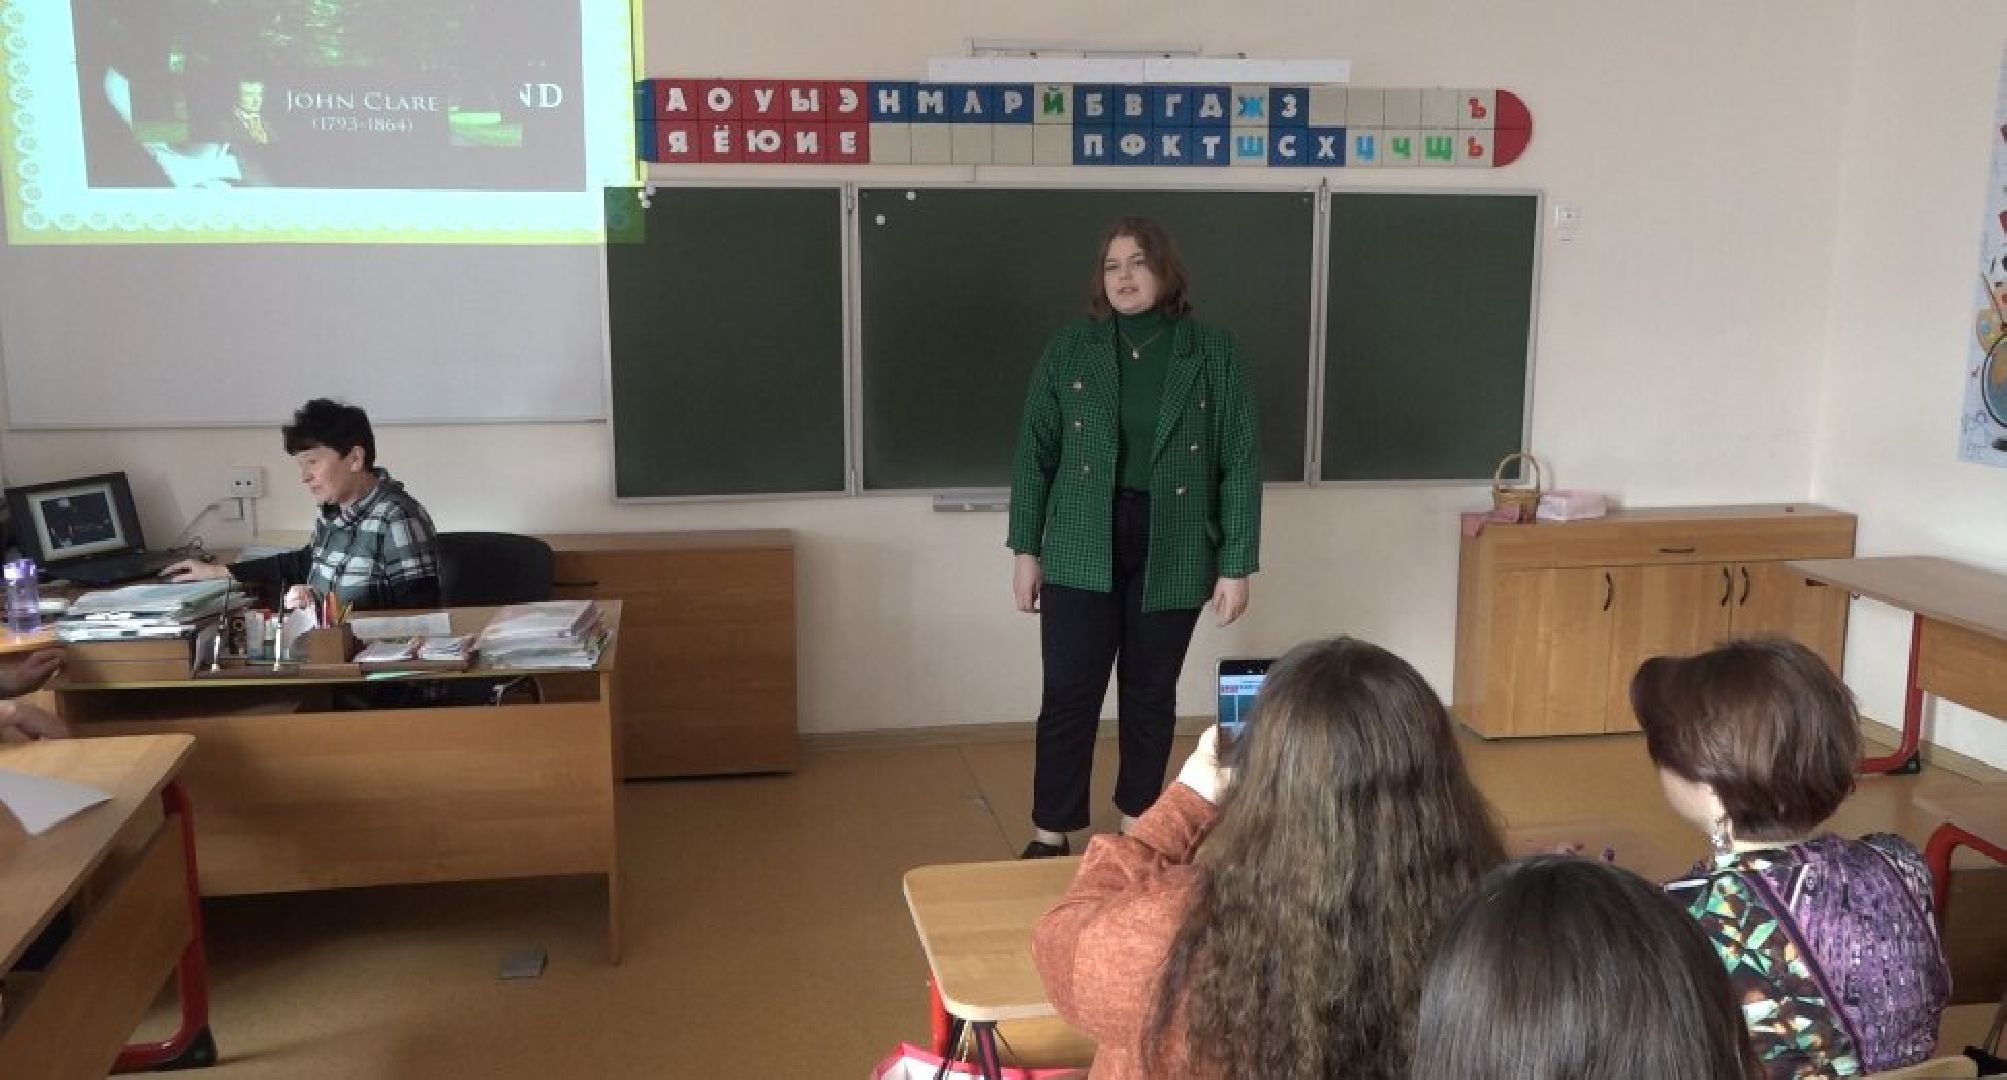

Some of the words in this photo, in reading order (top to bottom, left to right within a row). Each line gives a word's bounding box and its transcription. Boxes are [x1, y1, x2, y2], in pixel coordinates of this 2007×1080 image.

[286, 90, 354, 112] JOHN
[364, 91, 439, 112] CLARE
[666, 88, 687, 112] А
[707, 87, 733, 112] О
[755, 88, 774, 113] У
[790, 88, 820, 112] Ы
[838, 88, 859, 113] Э
[878, 89, 901, 114] Н
[917, 90, 944, 114] М
[963, 89, 983, 114] Л
[1004, 90, 1023, 114] Р
[1042, 86, 1065, 116] Й
[1085, 93, 1104, 116] Б
[1124, 93, 1142, 116] В
[1165, 93, 1182, 118] Г
[1199, 93, 1223, 118] Д
[1237, 95, 1264, 118] Ж
[1281, 94, 1297, 118] З
[1468, 97, 1487, 120] Ъ
[312, 115, 413, 132] (1793-1864)
[668, 130, 688, 153] Я
[713, 124, 730, 153] Ё
[747, 129, 781, 153] Ю
[795, 131, 818, 154] И
[840, 131, 857, 154] Е
[1083, 133, 1104, 157] П
[1120, 133, 1146, 157] Ф
[1161, 135, 1182, 157] К
[1202, 135, 1221, 160] Т
[1238, 135, 1264, 160] Ш
[1278, 135, 1297, 157] С
[1317, 135, 1336, 160] Х
[1355, 136, 1375, 161] Ц
[1392, 136, 1411, 160] Ч
[1425, 136, 1452, 161] Щ
[1467, 136, 1484, 160] Ь
